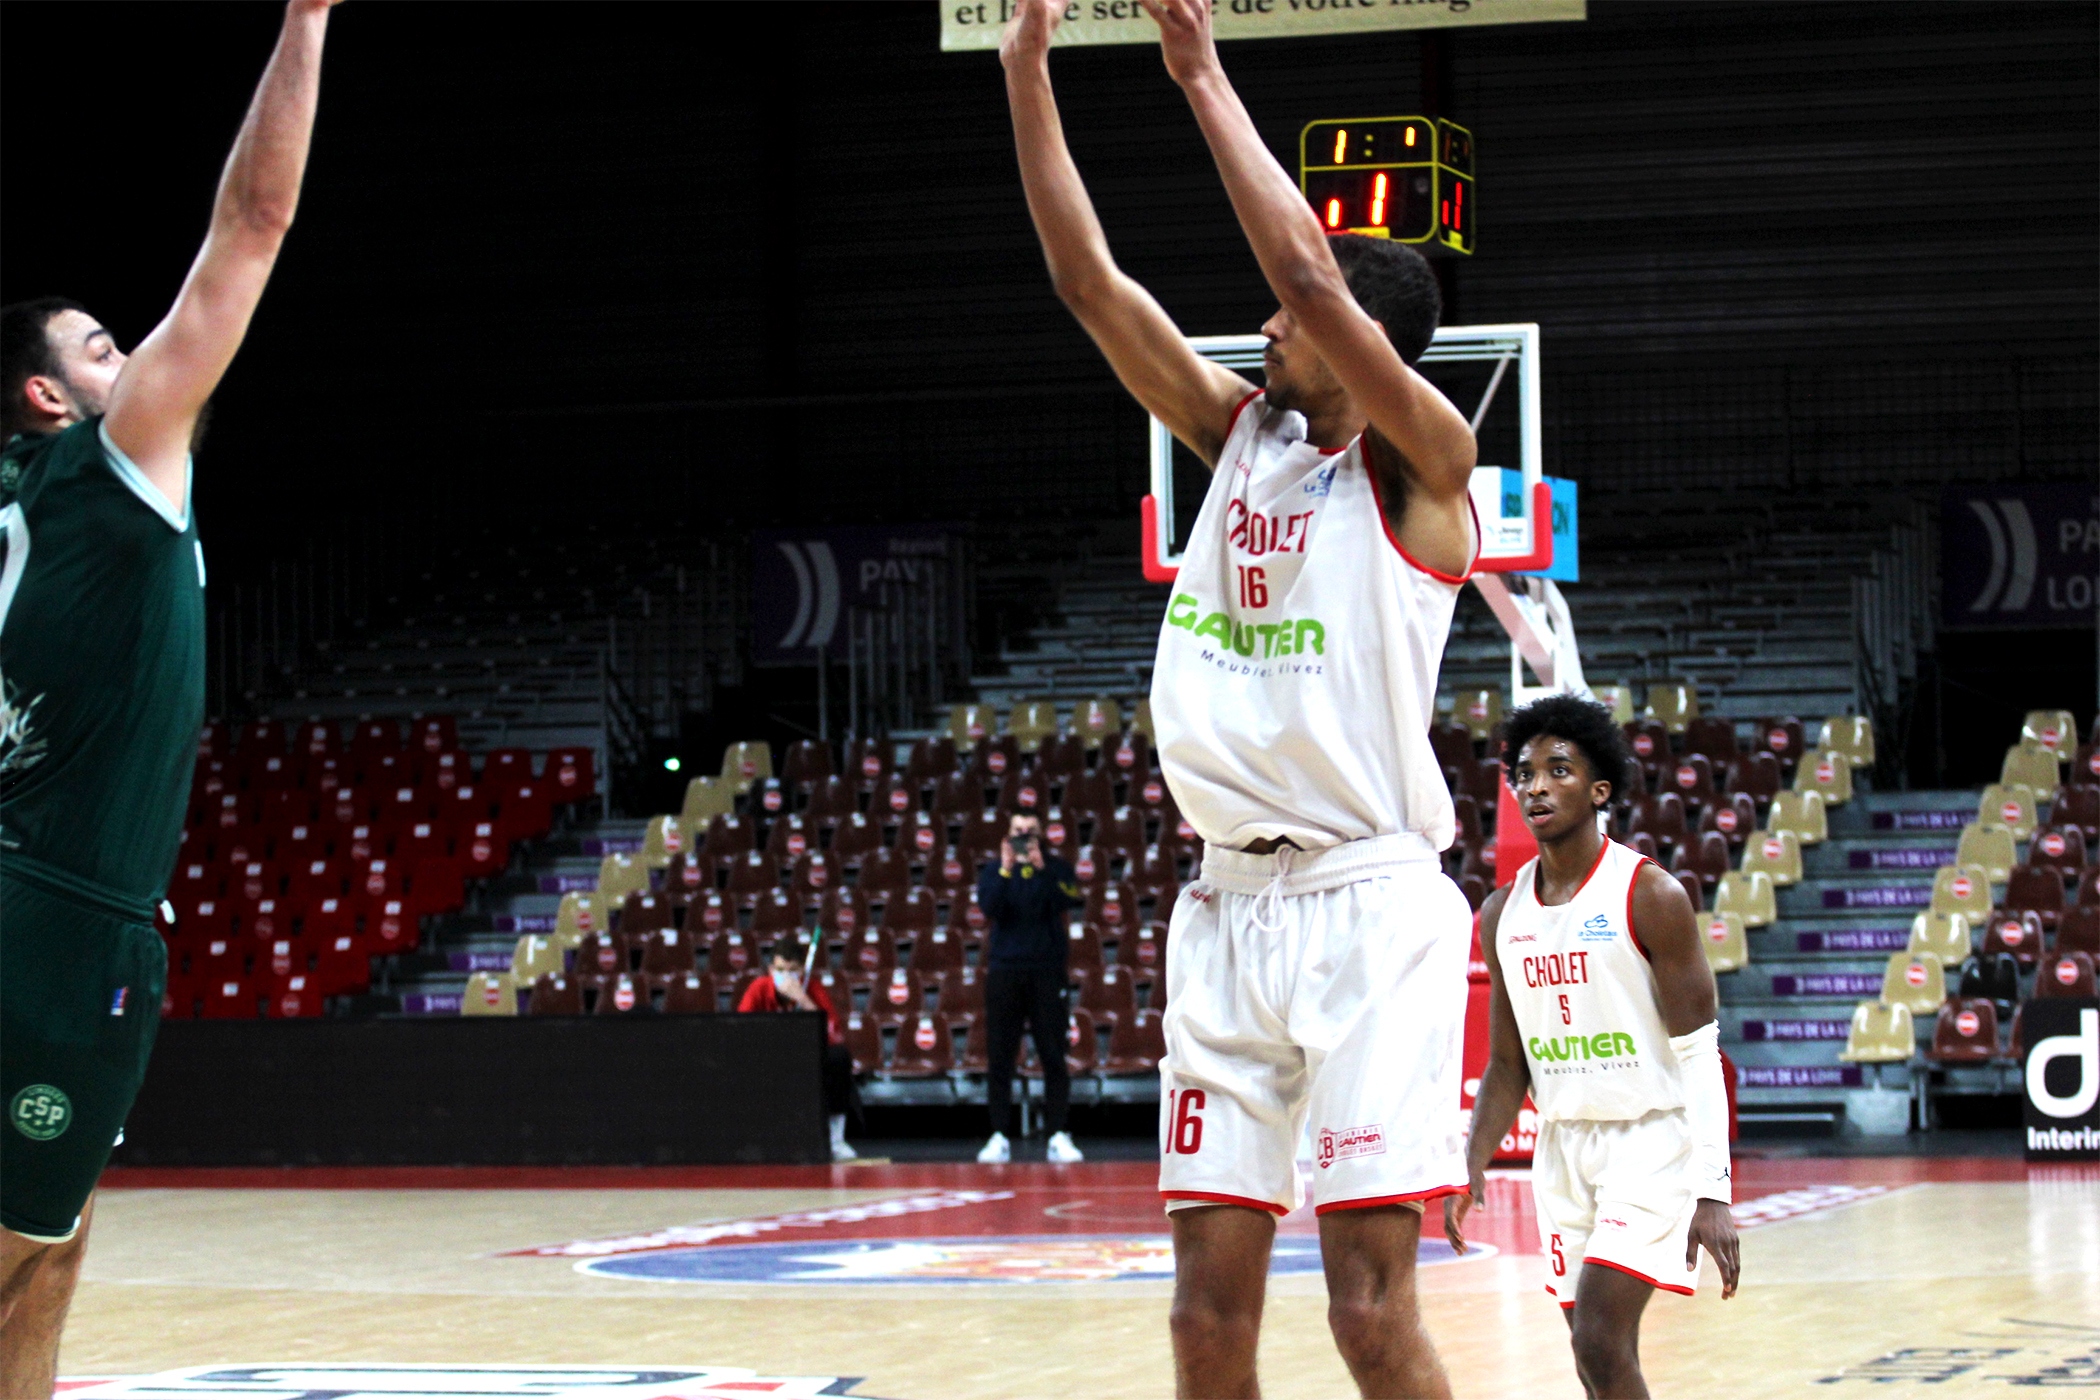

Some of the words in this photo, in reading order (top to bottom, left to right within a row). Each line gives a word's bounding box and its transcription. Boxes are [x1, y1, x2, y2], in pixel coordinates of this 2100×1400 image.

[955, 3, 986, 24] et
[1238, 565, 1268, 609] 16
[1524, 951, 1588, 988] CHOLET
[1558, 994, 1571, 1025] 5
[1529, 1032, 1637, 1062] GAUTIER
[18, 1095, 65, 1126] CSP
[1166, 1088, 1206, 1155] 16
